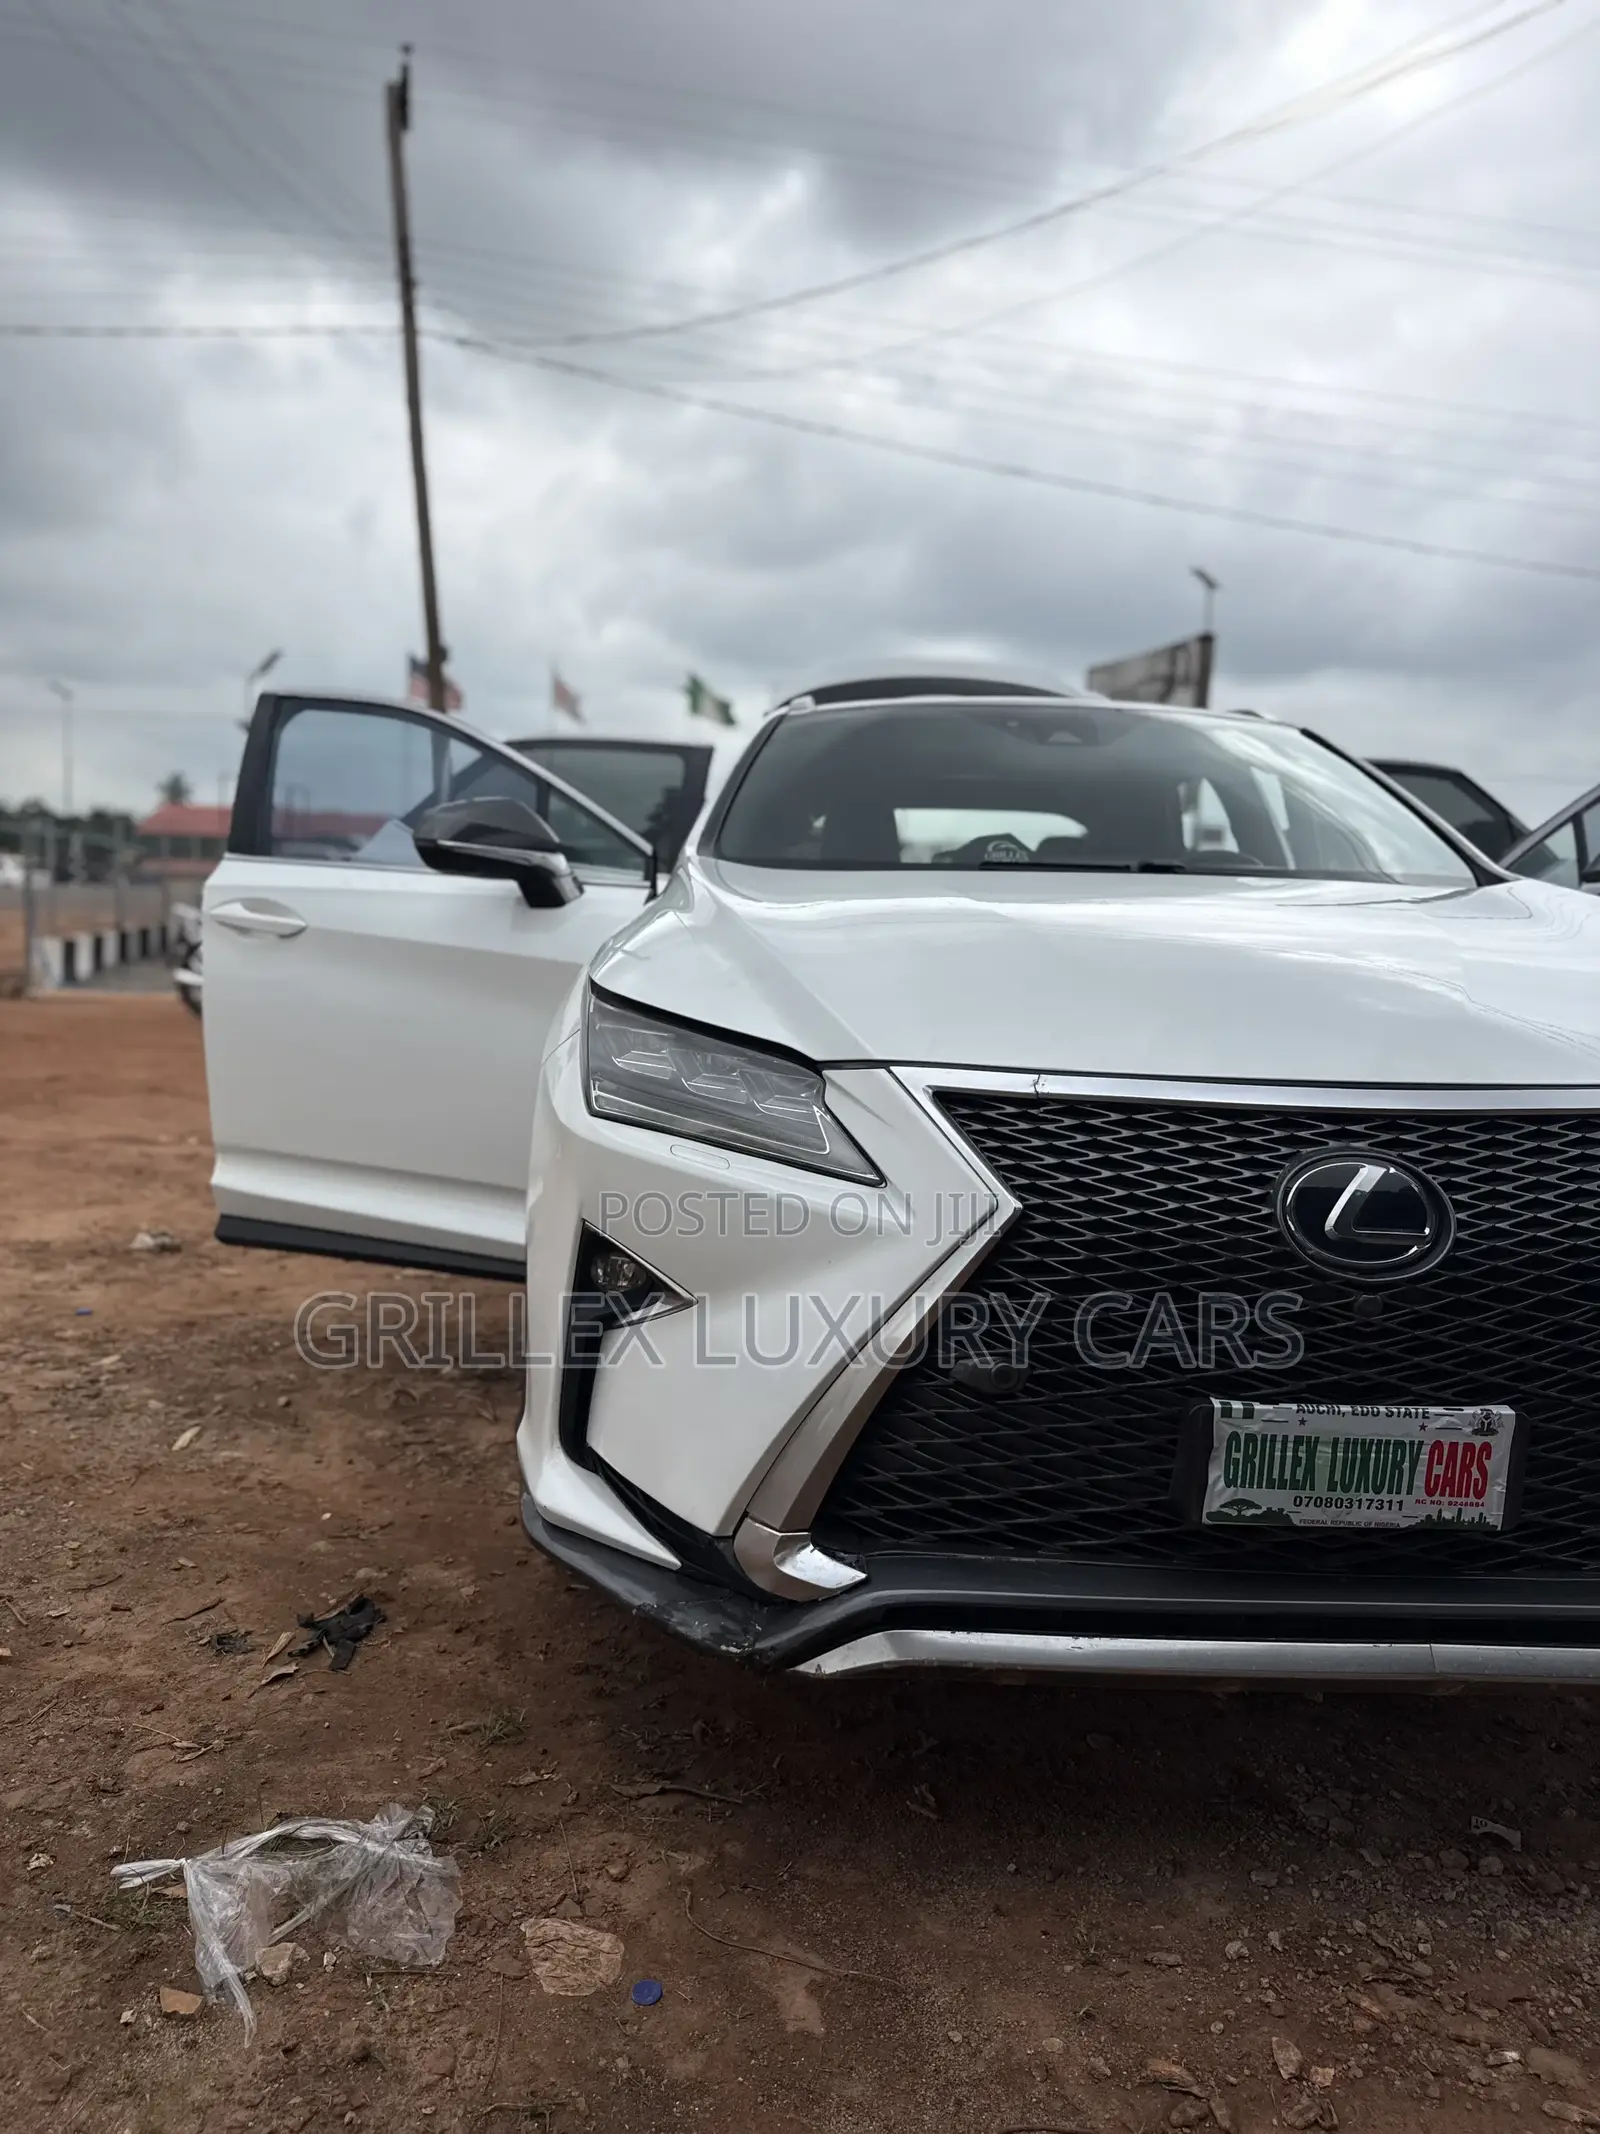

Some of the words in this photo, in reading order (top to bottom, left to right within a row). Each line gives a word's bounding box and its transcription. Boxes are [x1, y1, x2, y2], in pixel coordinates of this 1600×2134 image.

[1384, 1406, 1430, 1420] STATE
[1223, 1430, 1321, 1491] GRILLEX
[1327, 1437, 1424, 1496] LUXURY
[1424, 1440, 1492, 1500] CARS
[1292, 1495, 1404, 1512] 07080317311
[1299, 1518, 1328, 1526] FEDERAL
[1330, 1519, 1362, 1527] REPUBLIC
